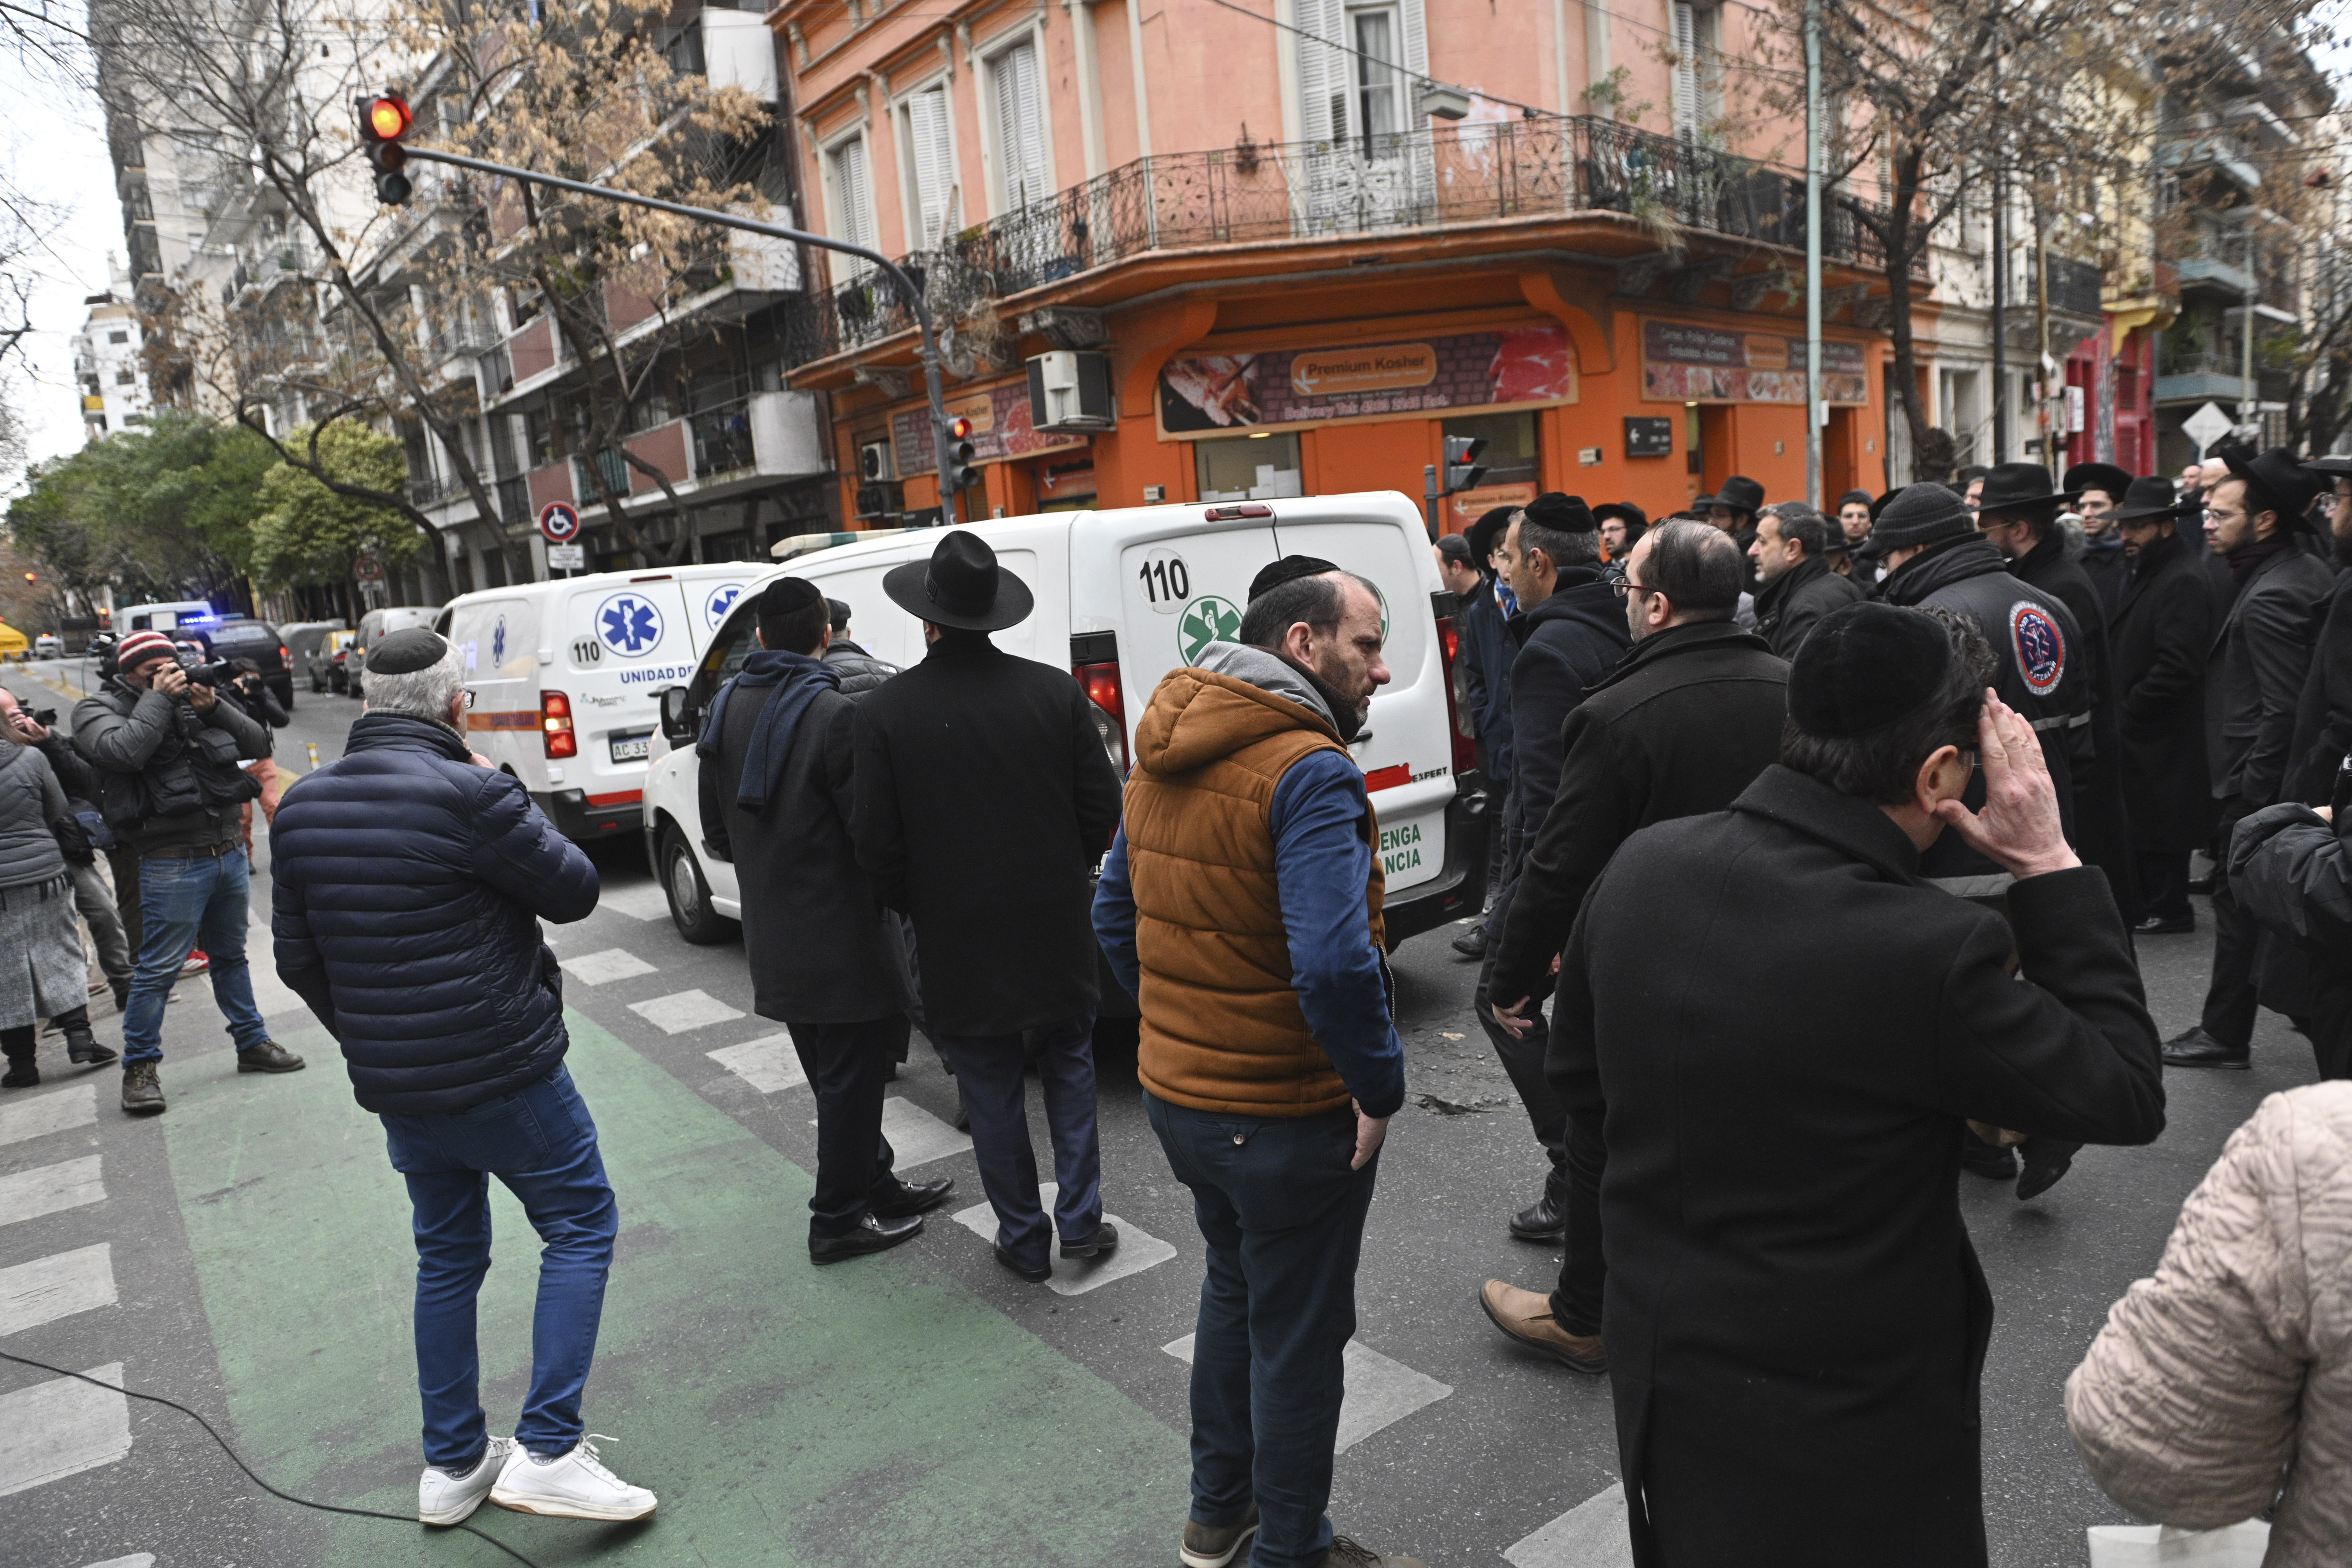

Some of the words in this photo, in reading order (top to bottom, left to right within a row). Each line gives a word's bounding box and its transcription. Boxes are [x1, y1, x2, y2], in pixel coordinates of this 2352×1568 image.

[1308, 360, 1371, 375] Premium
[1375, 355, 1426, 370] Kosher
[1284, 406, 1335, 420] Delivery
[1140, 558, 1189, 603] 110
[573, 641, 600, 662] 110
[620, 668, 675, 684] UNIDAD
[2026, 667, 2064, 694] EMERGENCIA
[615, 744, 629, 756] AC
[633, 740, 651, 754] 33
[1412, 766, 1447, 783] EXPERT
[1380, 824, 1421, 852] ENGA
[1379, 848, 1421, 875] NCIA
